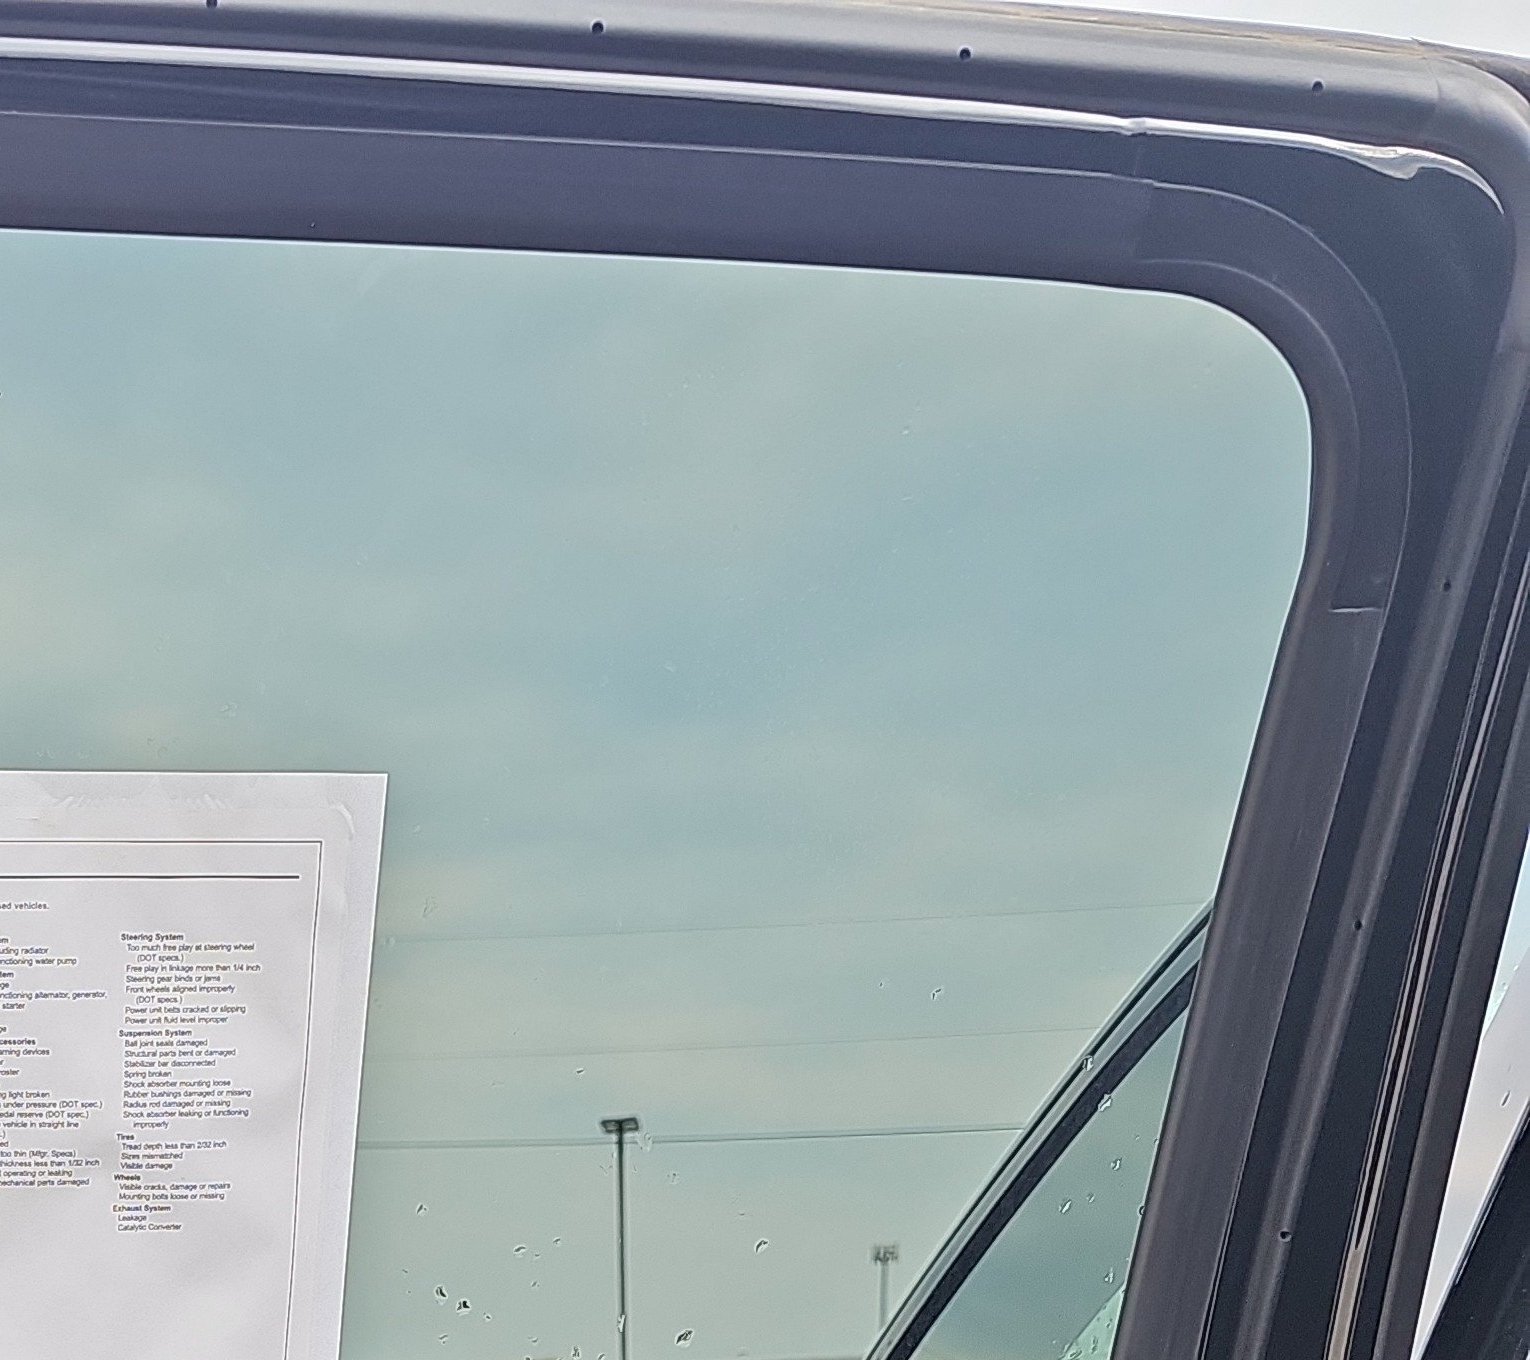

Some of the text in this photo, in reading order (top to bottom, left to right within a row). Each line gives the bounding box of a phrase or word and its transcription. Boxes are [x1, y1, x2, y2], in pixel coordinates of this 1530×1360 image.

[121, 933, 183, 942] Steering System
[21, 946, 48, 954] radiator
[141, 943, 160, 951] much
[163, 943, 176, 951] free
[178, 943, 193, 952] play
[203, 943, 231, 952] steering
[119, 1029, 192, 1038] Suspension System
[124, 1070, 146, 1079] Spring
[3, 1100, 24, 1108] under
[114, 1173, 140, 1181] Wheels
[119, 1192, 150, 1201] Mounting
[152, 1192, 168, 1200] bolts
[170, 1192, 188, 1200] loose
[199, 1192, 224, 1201] missing
[112, 1204, 171, 1213] Exhaust System
[118, 1214, 146, 1222] Leakage
[118, 1222, 181, 1232] Catalytic Converter
